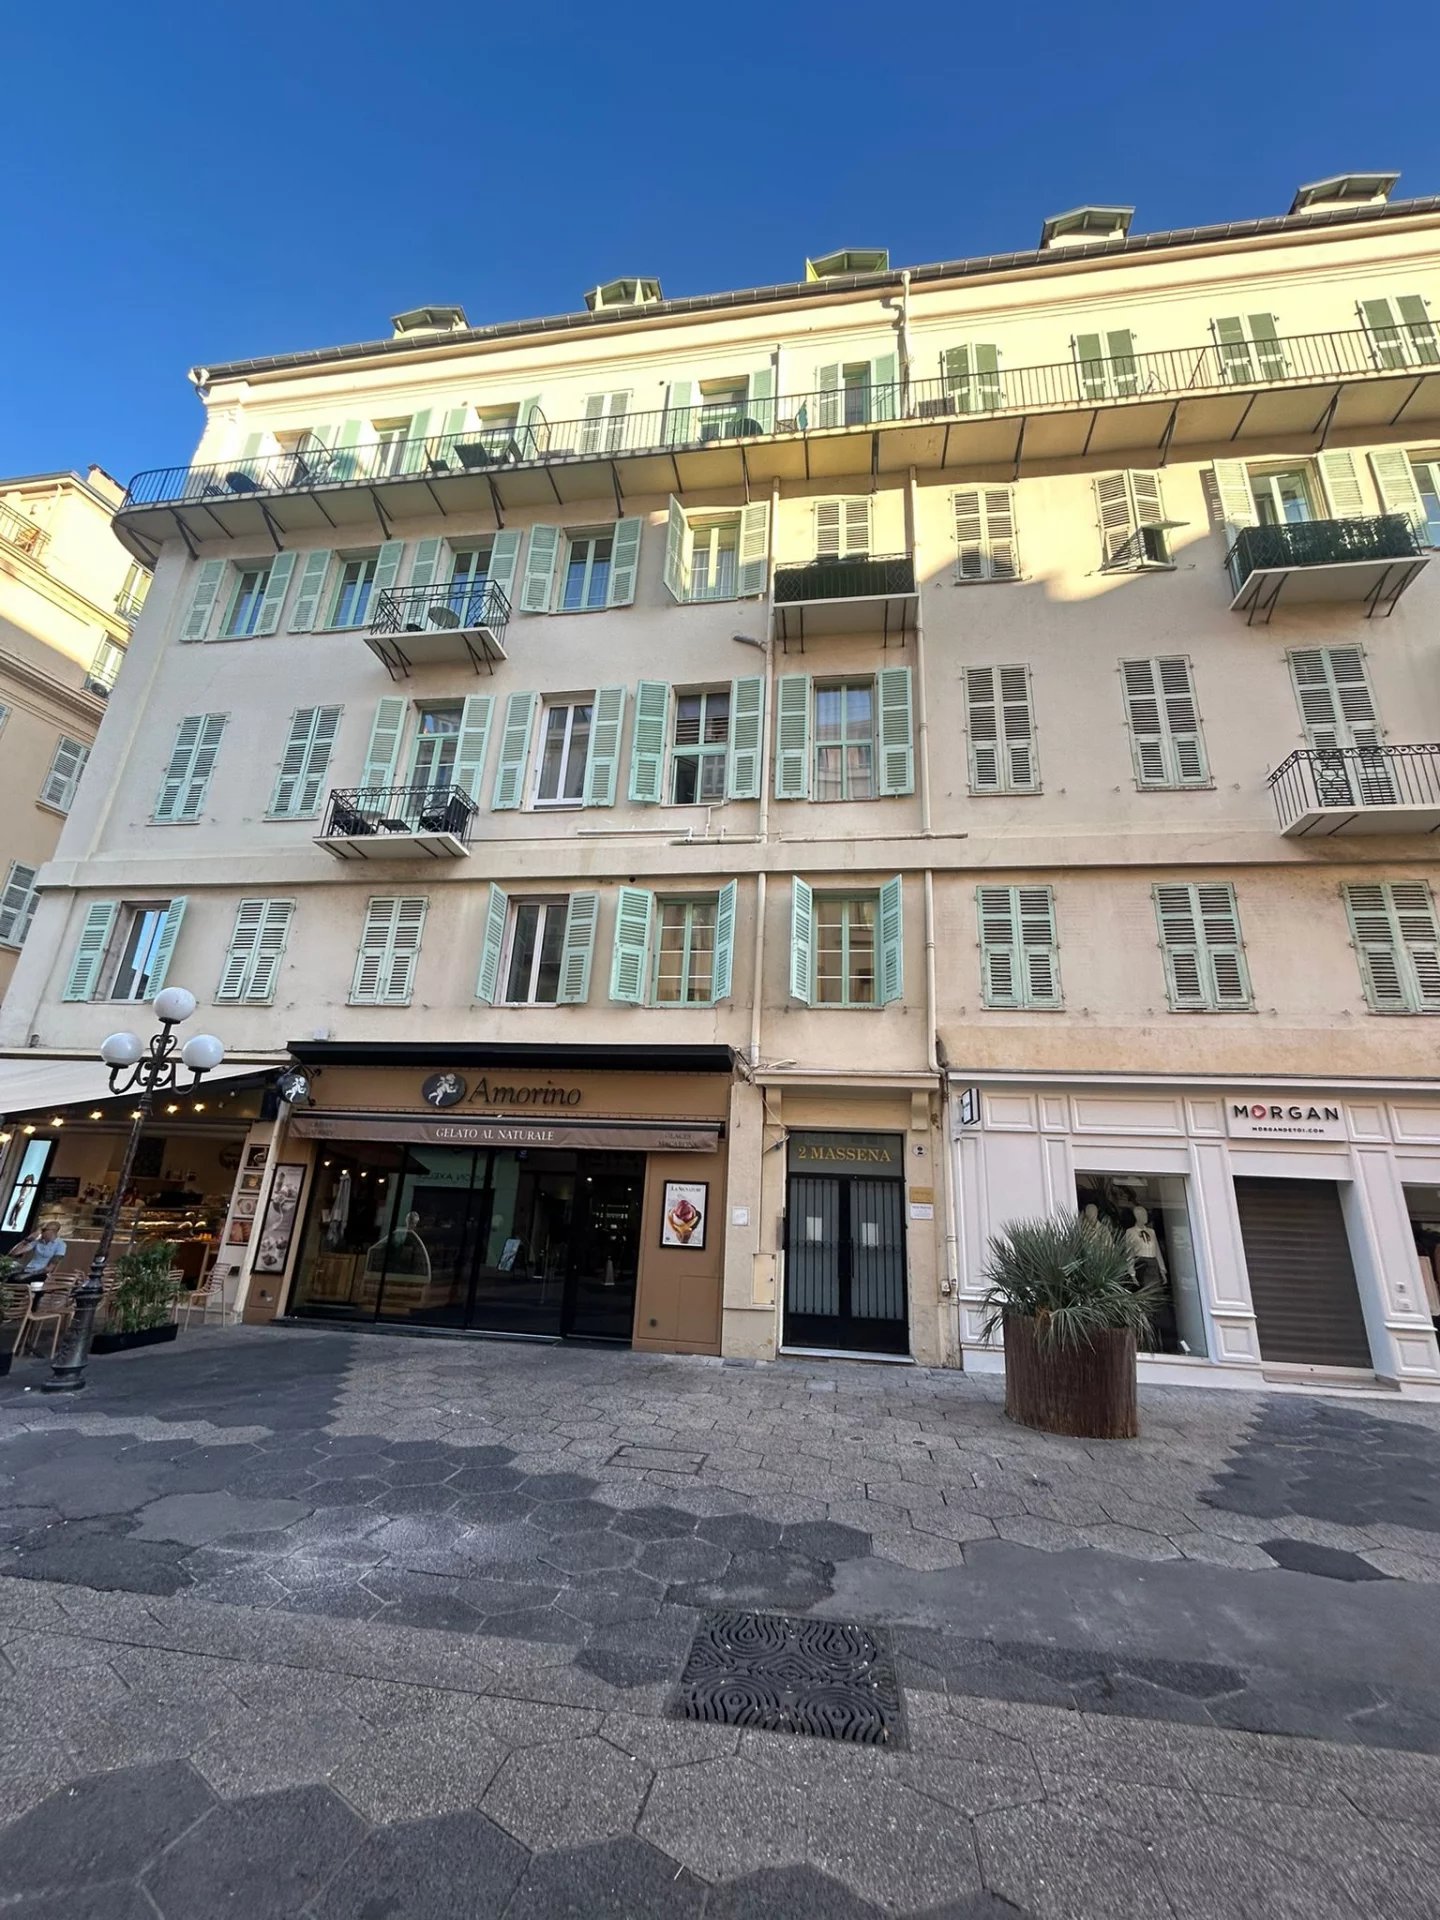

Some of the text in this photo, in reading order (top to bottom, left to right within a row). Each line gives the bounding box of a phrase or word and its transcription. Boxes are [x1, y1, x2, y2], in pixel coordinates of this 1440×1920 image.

[468, 1077, 582, 1105] Amorino
[1233, 1104, 1339, 1120] MORGAN
[436, 1127, 554, 1140] GELATO AL NATURALE
[1252, 1126, 1325, 1134] MORGANDETOI.COM
[798, 1146, 892, 1162] 2 MASSENA
